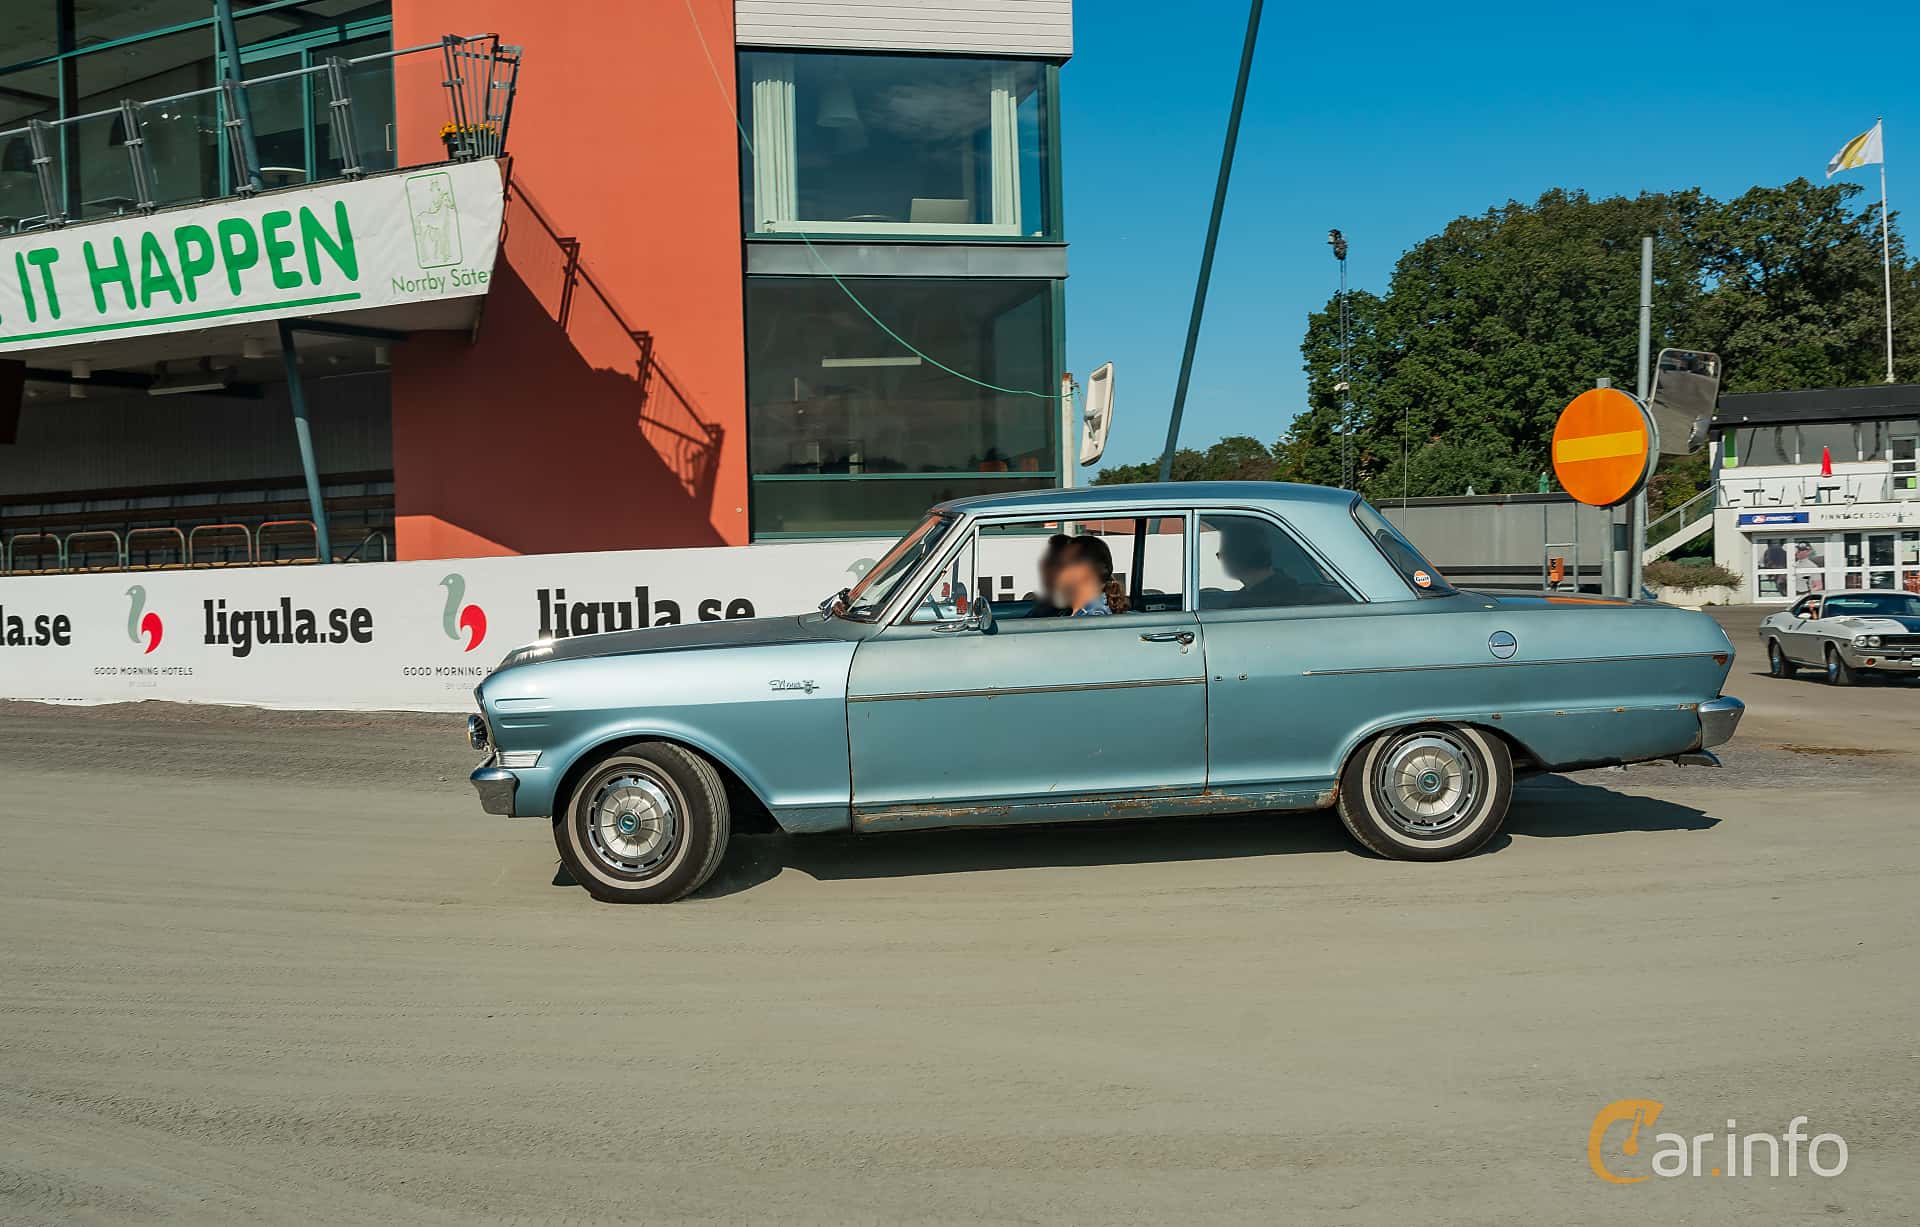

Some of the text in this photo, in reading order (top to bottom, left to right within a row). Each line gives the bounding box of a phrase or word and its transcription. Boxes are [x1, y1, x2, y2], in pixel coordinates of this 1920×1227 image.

[15, 200, 360, 323] IT HAPPEN
[391, 267, 491, 294] Norrby Säte
[203, 597, 373, 657] ligula.se
[537, 586, 755, 640] ligulase
[94, 666, 193, 676] GOOD MORNING HOTELS
[403, 667, 432, 676] GOOD
[435, 667, 482, 676] MORNING
